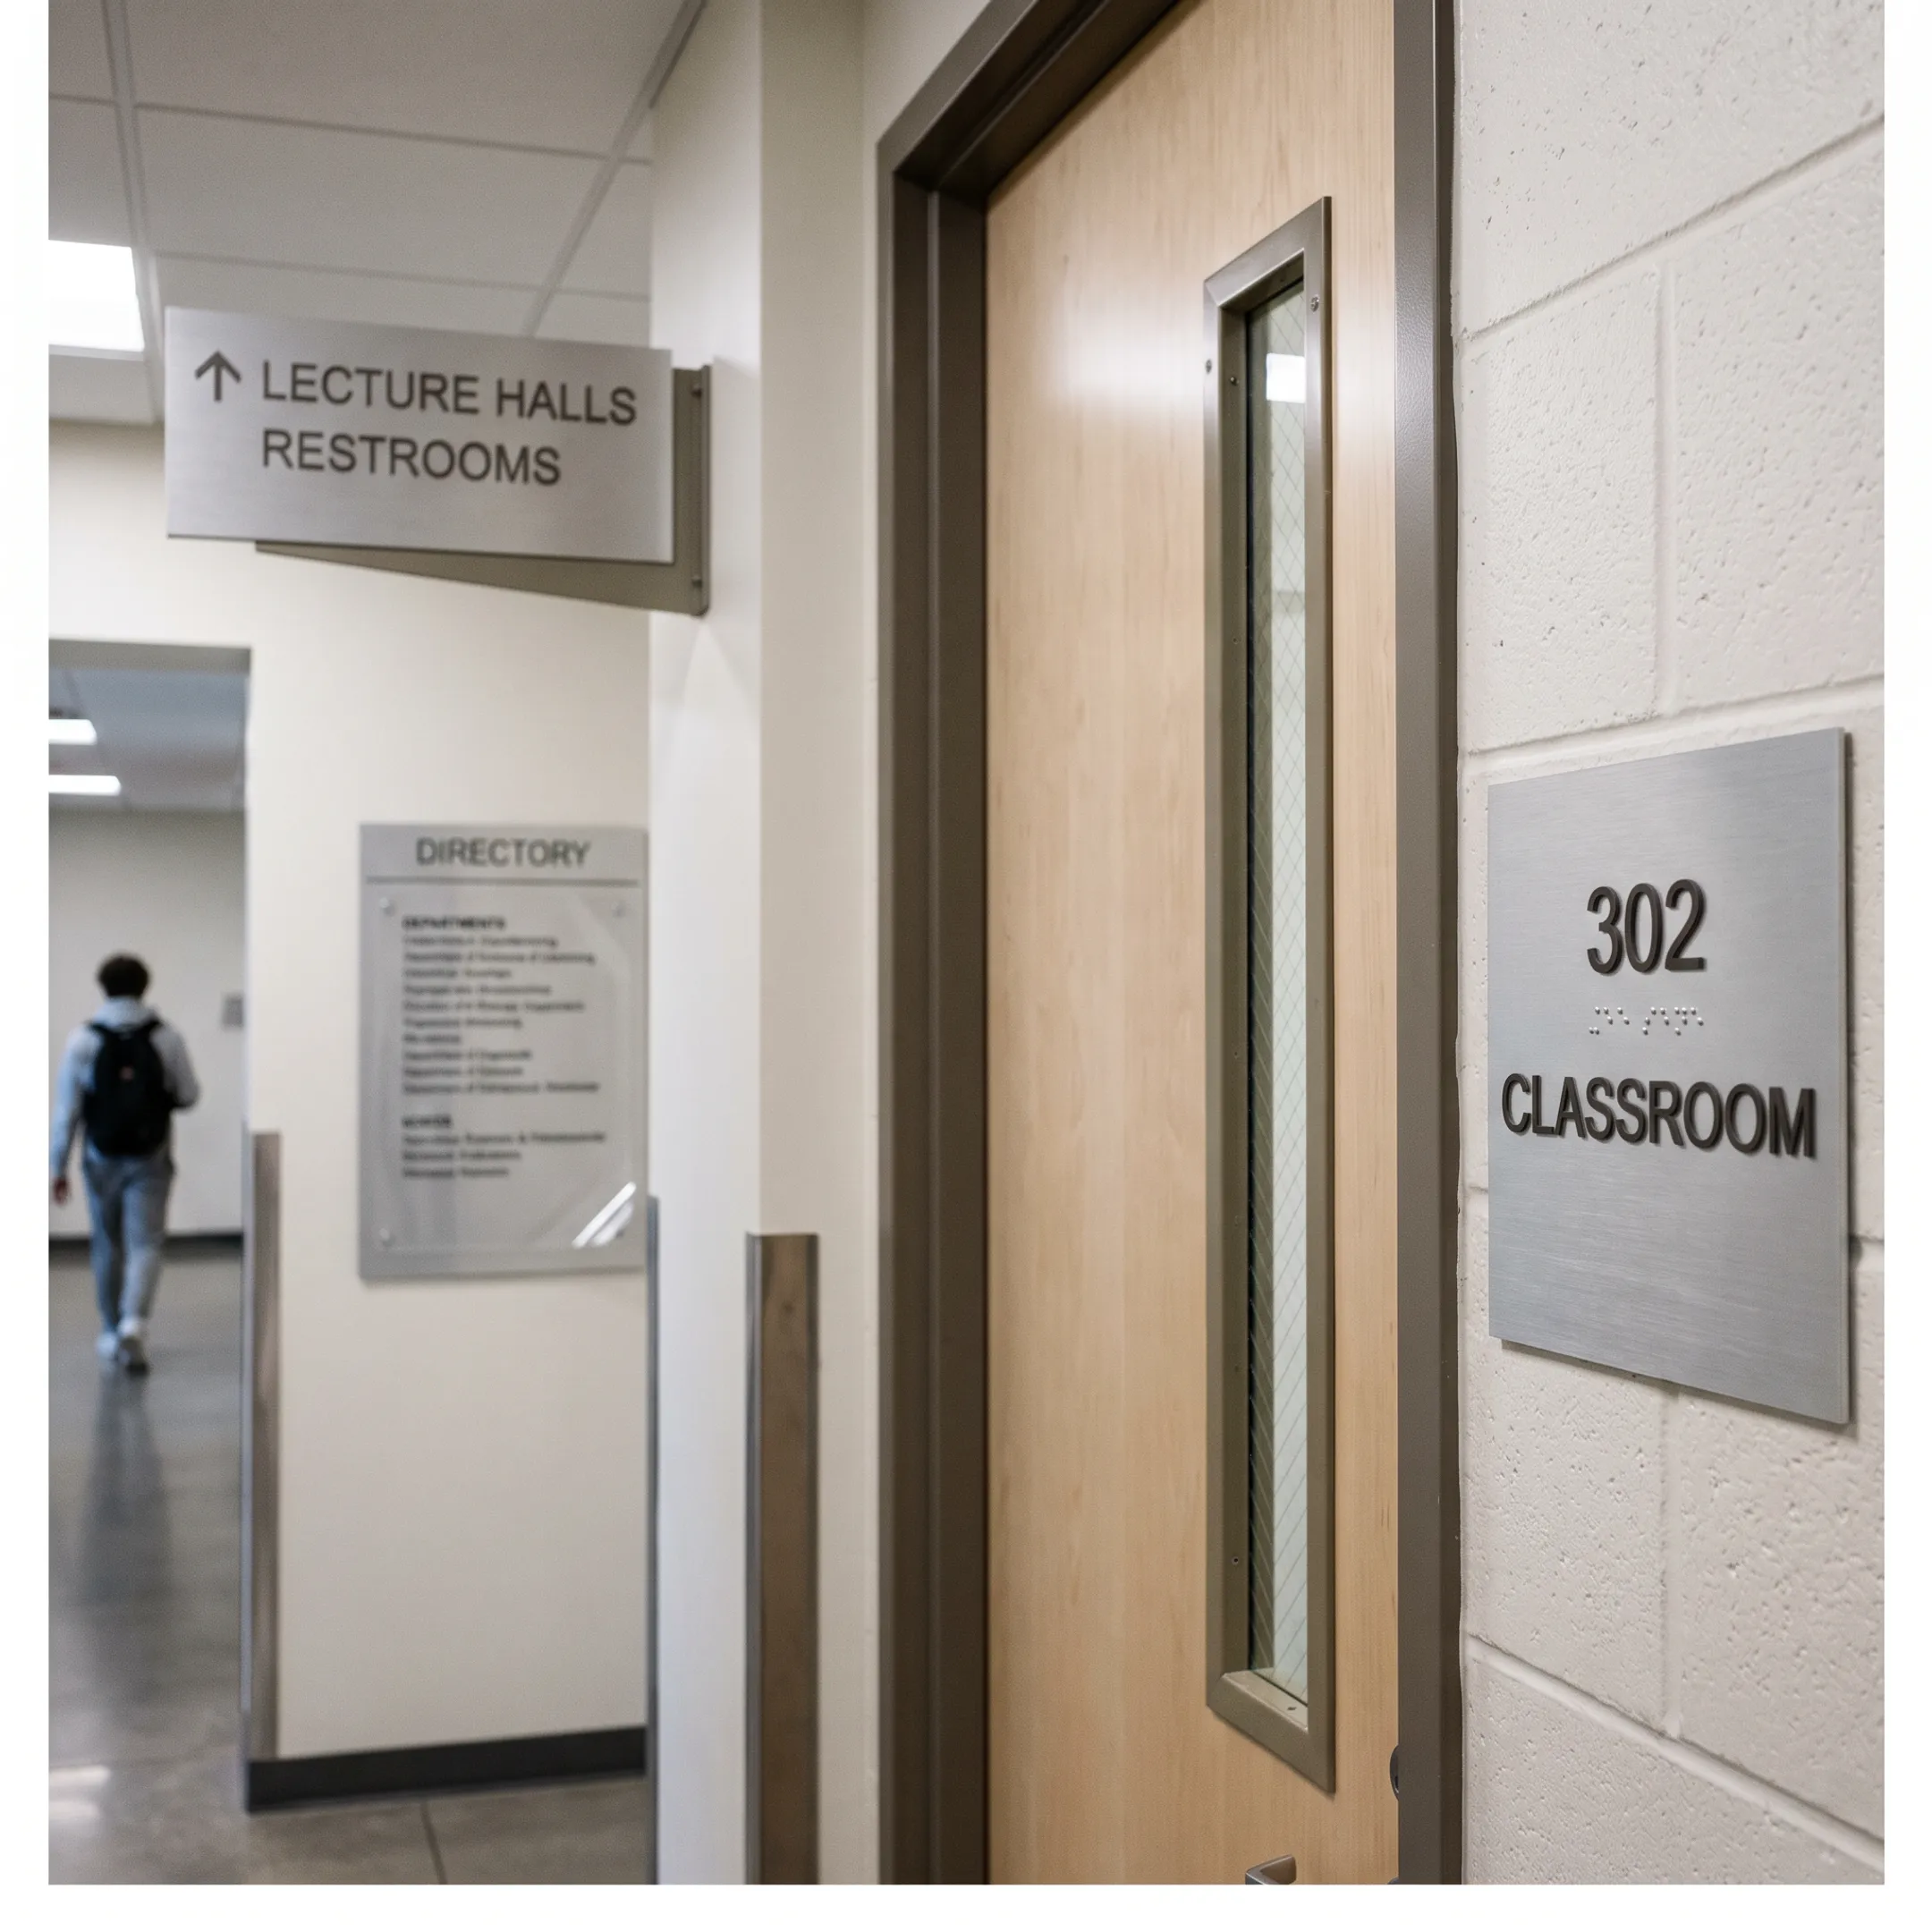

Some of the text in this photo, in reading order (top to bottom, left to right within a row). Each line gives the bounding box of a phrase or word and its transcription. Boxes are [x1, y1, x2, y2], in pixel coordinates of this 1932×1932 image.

[263, 360, 638, 426] LECTURE HALLS
[263, 428, 562, 486] RESTROOMS
[415, 836, 590, 867] DIRECTORY
[1587, 879, 1707, 974] 302
[1502, 1073, 1817, 1158] CLASSROOM
